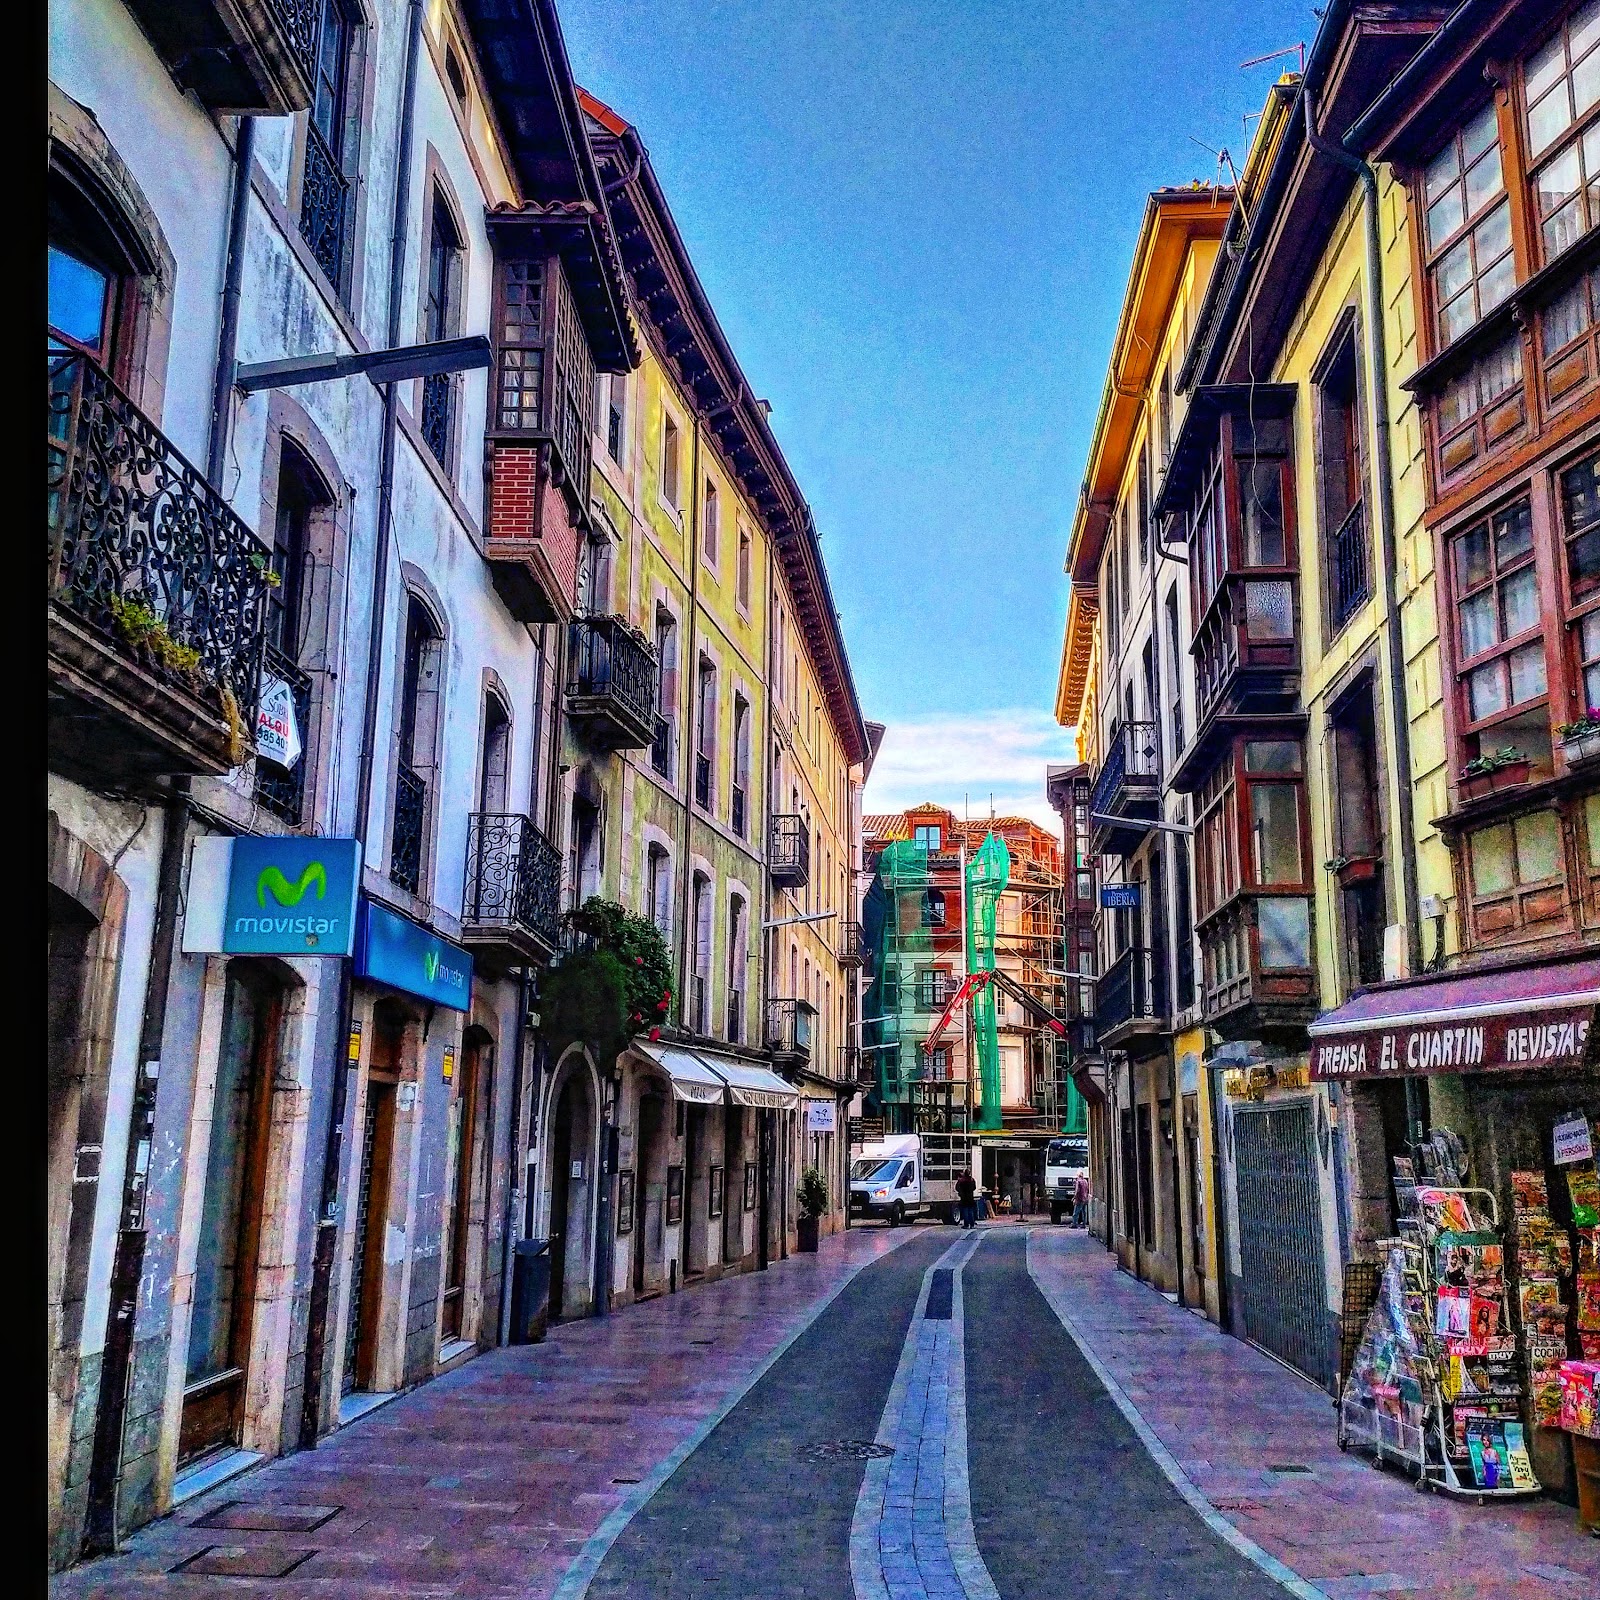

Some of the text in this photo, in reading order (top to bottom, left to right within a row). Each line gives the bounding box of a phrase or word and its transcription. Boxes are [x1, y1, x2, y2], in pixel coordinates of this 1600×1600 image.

[1107, 895, 1136, 907] IBERIA
[234, 915, 340, 935] movistar
[1318, 1020, 1589, 1075] PRENSA EL CUARTIN REVISTAS
[1451, 1345, 1486, 1356] muy
[1488, 1351, 1514, 1361] muy
